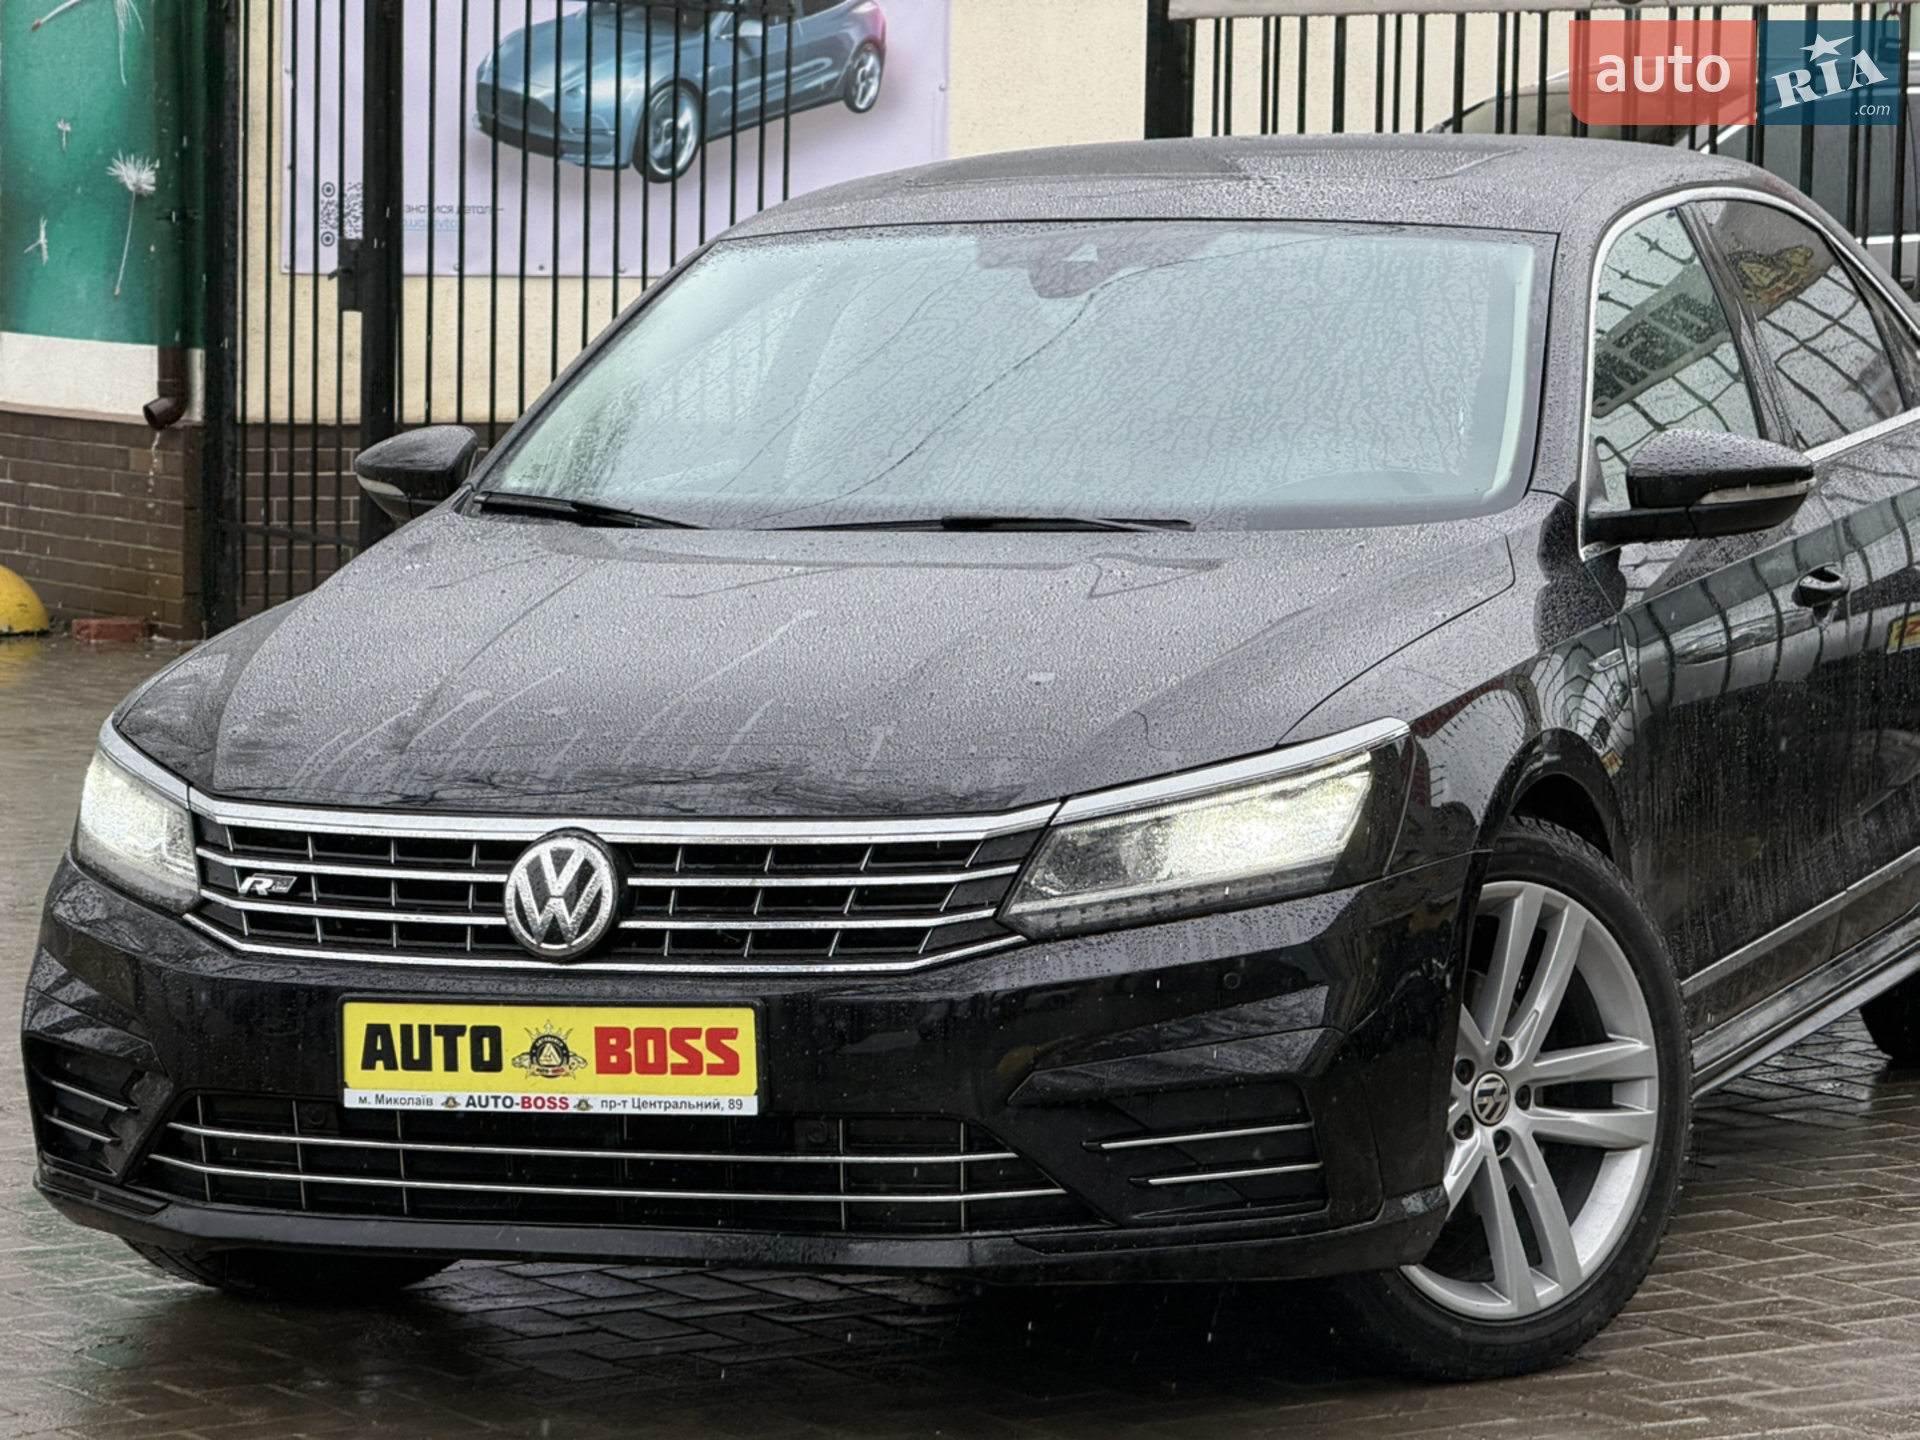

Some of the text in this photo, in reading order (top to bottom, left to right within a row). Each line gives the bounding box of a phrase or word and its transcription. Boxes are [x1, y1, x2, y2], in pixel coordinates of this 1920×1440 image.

[361, 1023, 740, 1076] AUTO BOSS
[358, 1094, 433, 1106] м. Миколаїв
[465, 1095, 569, 1110] AUTO-BOSS
[601, 1098, 743, 1111] пр-т Центральний, 89
